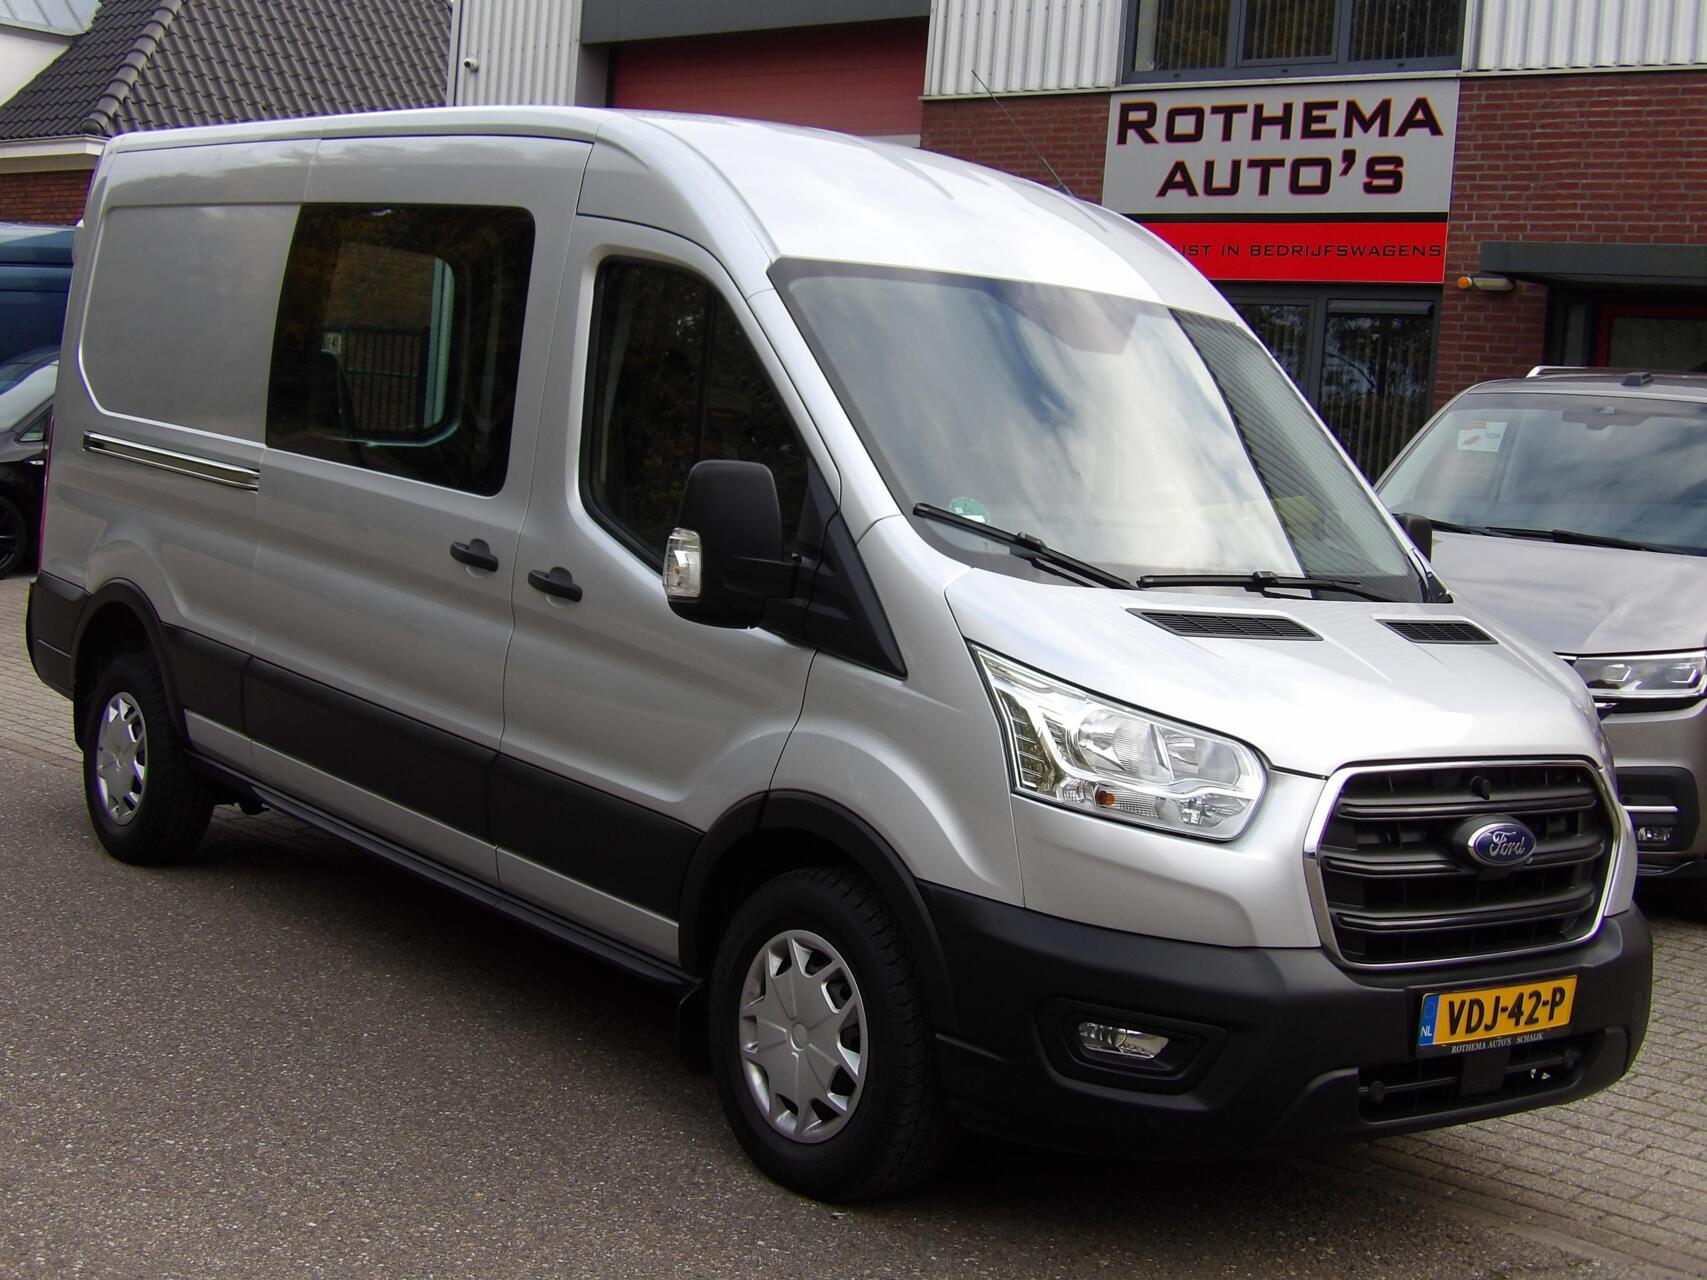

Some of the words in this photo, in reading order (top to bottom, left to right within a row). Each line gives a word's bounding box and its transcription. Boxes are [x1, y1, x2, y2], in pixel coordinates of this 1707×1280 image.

[1116, 97, 1444, 146] ROTHEMA
[1156, 149, 1404, 198] AUTO'S
[1221, 244, 1240, 257] IN
[1250, 243, 1442, 257] BEDRIJFSWAGENS
[1489, 830, 1525, 857] Ford
[1420, 1025, 1432, 1037] NL
[1448, 986, 1566, 1036] VDJ-42-P
[1451, 1042, 1487, 1054] ROTHEMA
